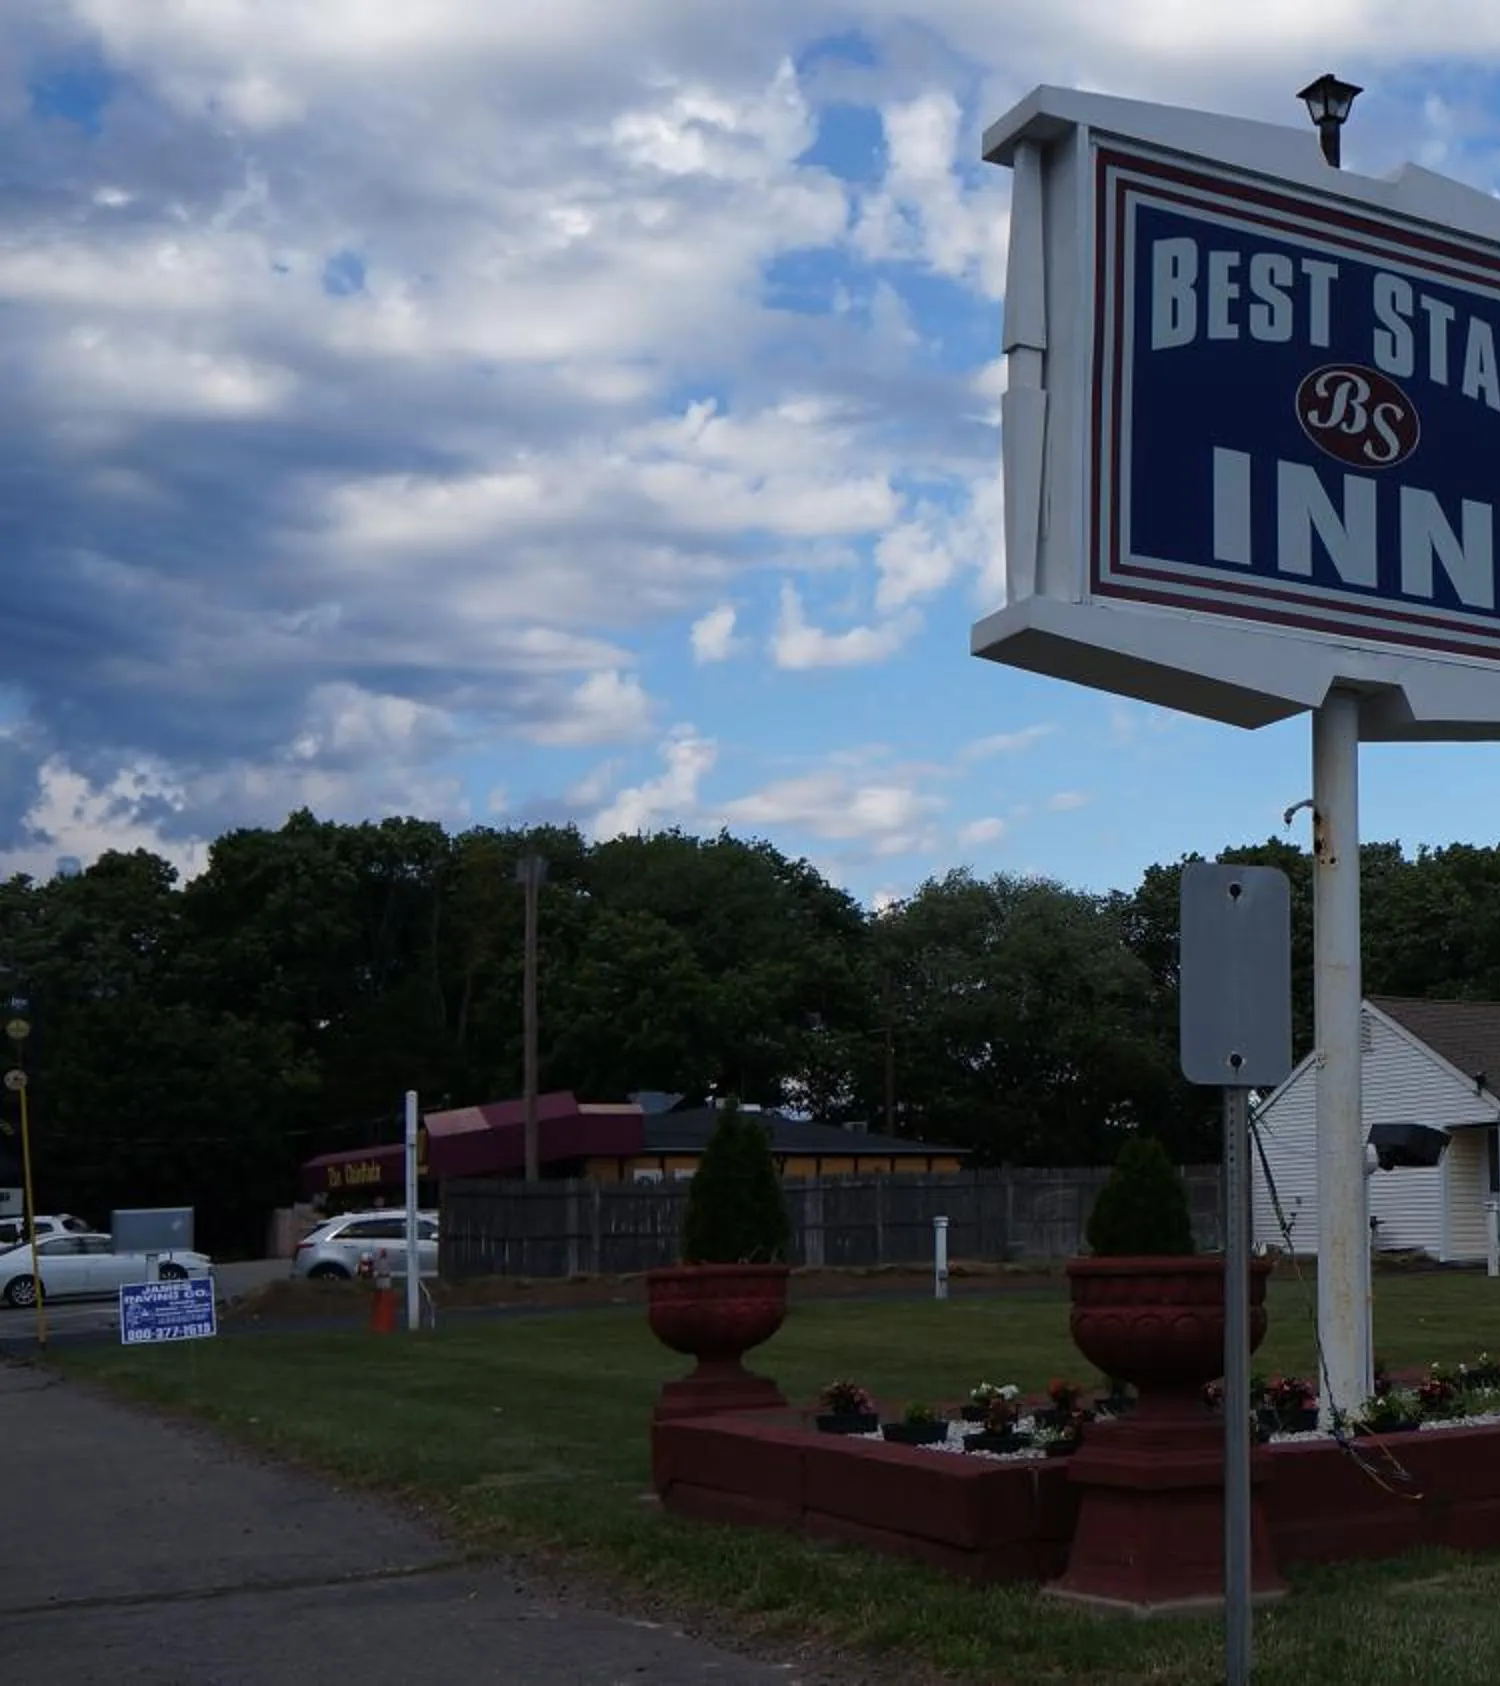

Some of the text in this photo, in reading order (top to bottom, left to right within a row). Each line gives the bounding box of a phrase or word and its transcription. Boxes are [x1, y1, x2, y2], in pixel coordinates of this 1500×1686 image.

[1152, 237, 1338, 350] BEST
[1307, 371, 1404, 464] BS
[1213, 446, 1495, 609] INN
